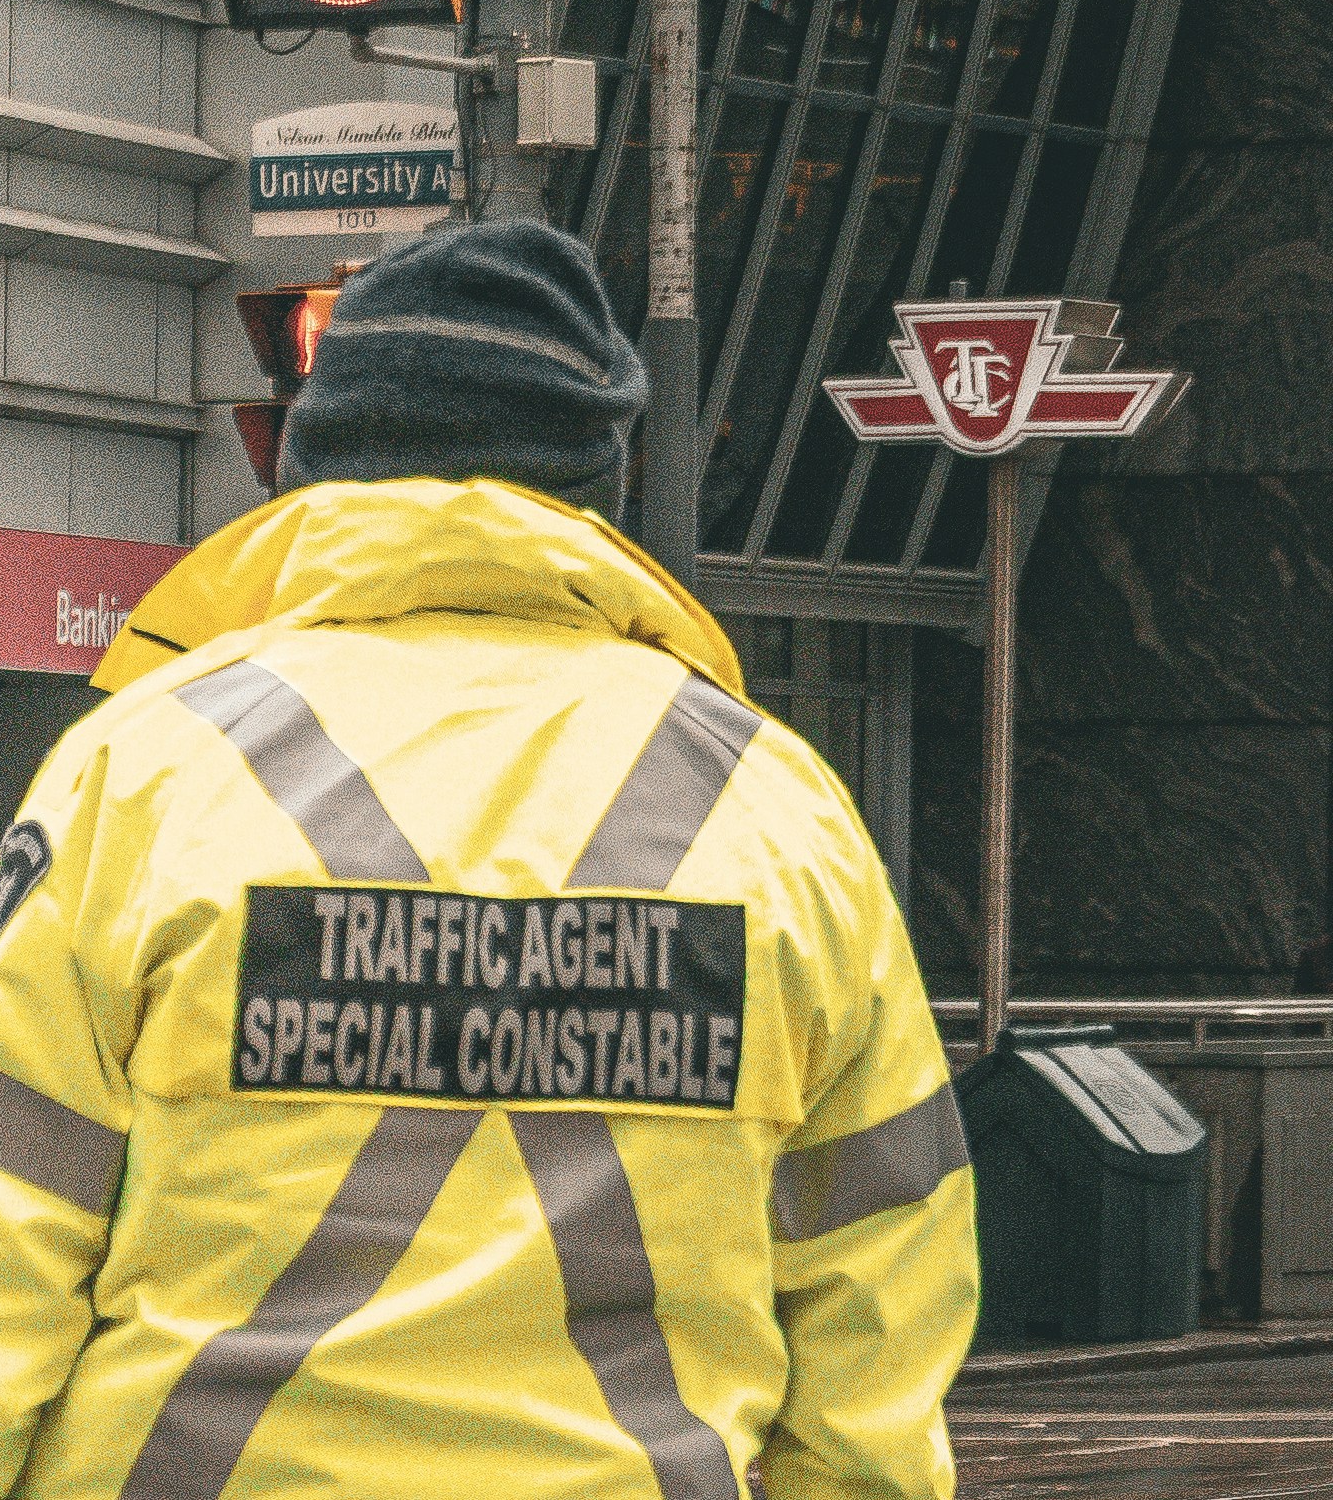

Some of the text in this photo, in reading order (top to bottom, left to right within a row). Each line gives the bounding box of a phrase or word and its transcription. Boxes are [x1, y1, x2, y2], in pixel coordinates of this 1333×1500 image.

[259, 157, 421, 200] University
[337, 210, 377, 229] 100
[314, 893, 679, 990] TRAFFIC AGENT
[239, 996, 739, 1102] SPECIAL CONSTABLE
